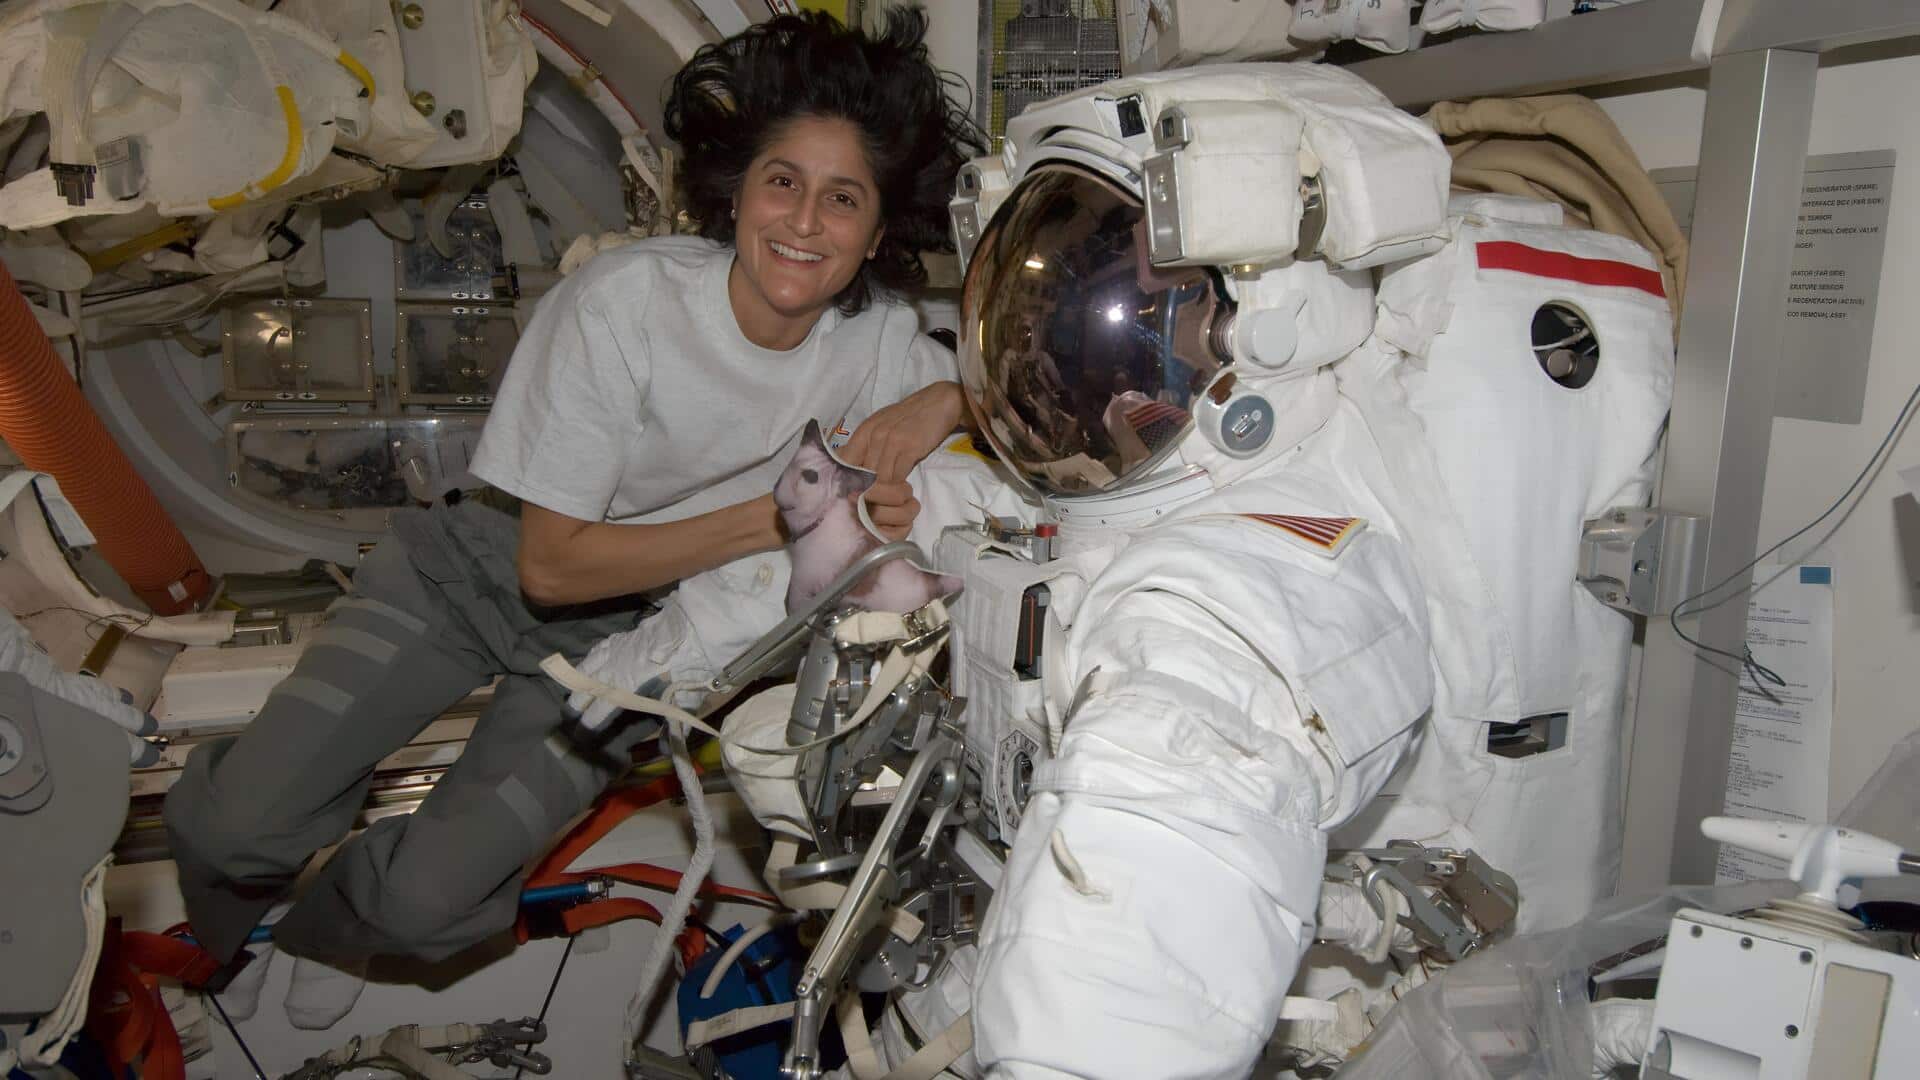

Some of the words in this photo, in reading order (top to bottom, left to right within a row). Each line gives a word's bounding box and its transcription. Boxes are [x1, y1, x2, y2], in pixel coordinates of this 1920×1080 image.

[1806, 185, 1852, 193] REGENERATOR
[1807, 214, 1832, 222] SENSOR
[1792, 297, 1838, 305] REGENERATOR
[1800, 311, 1829, 319] REMOVAL
